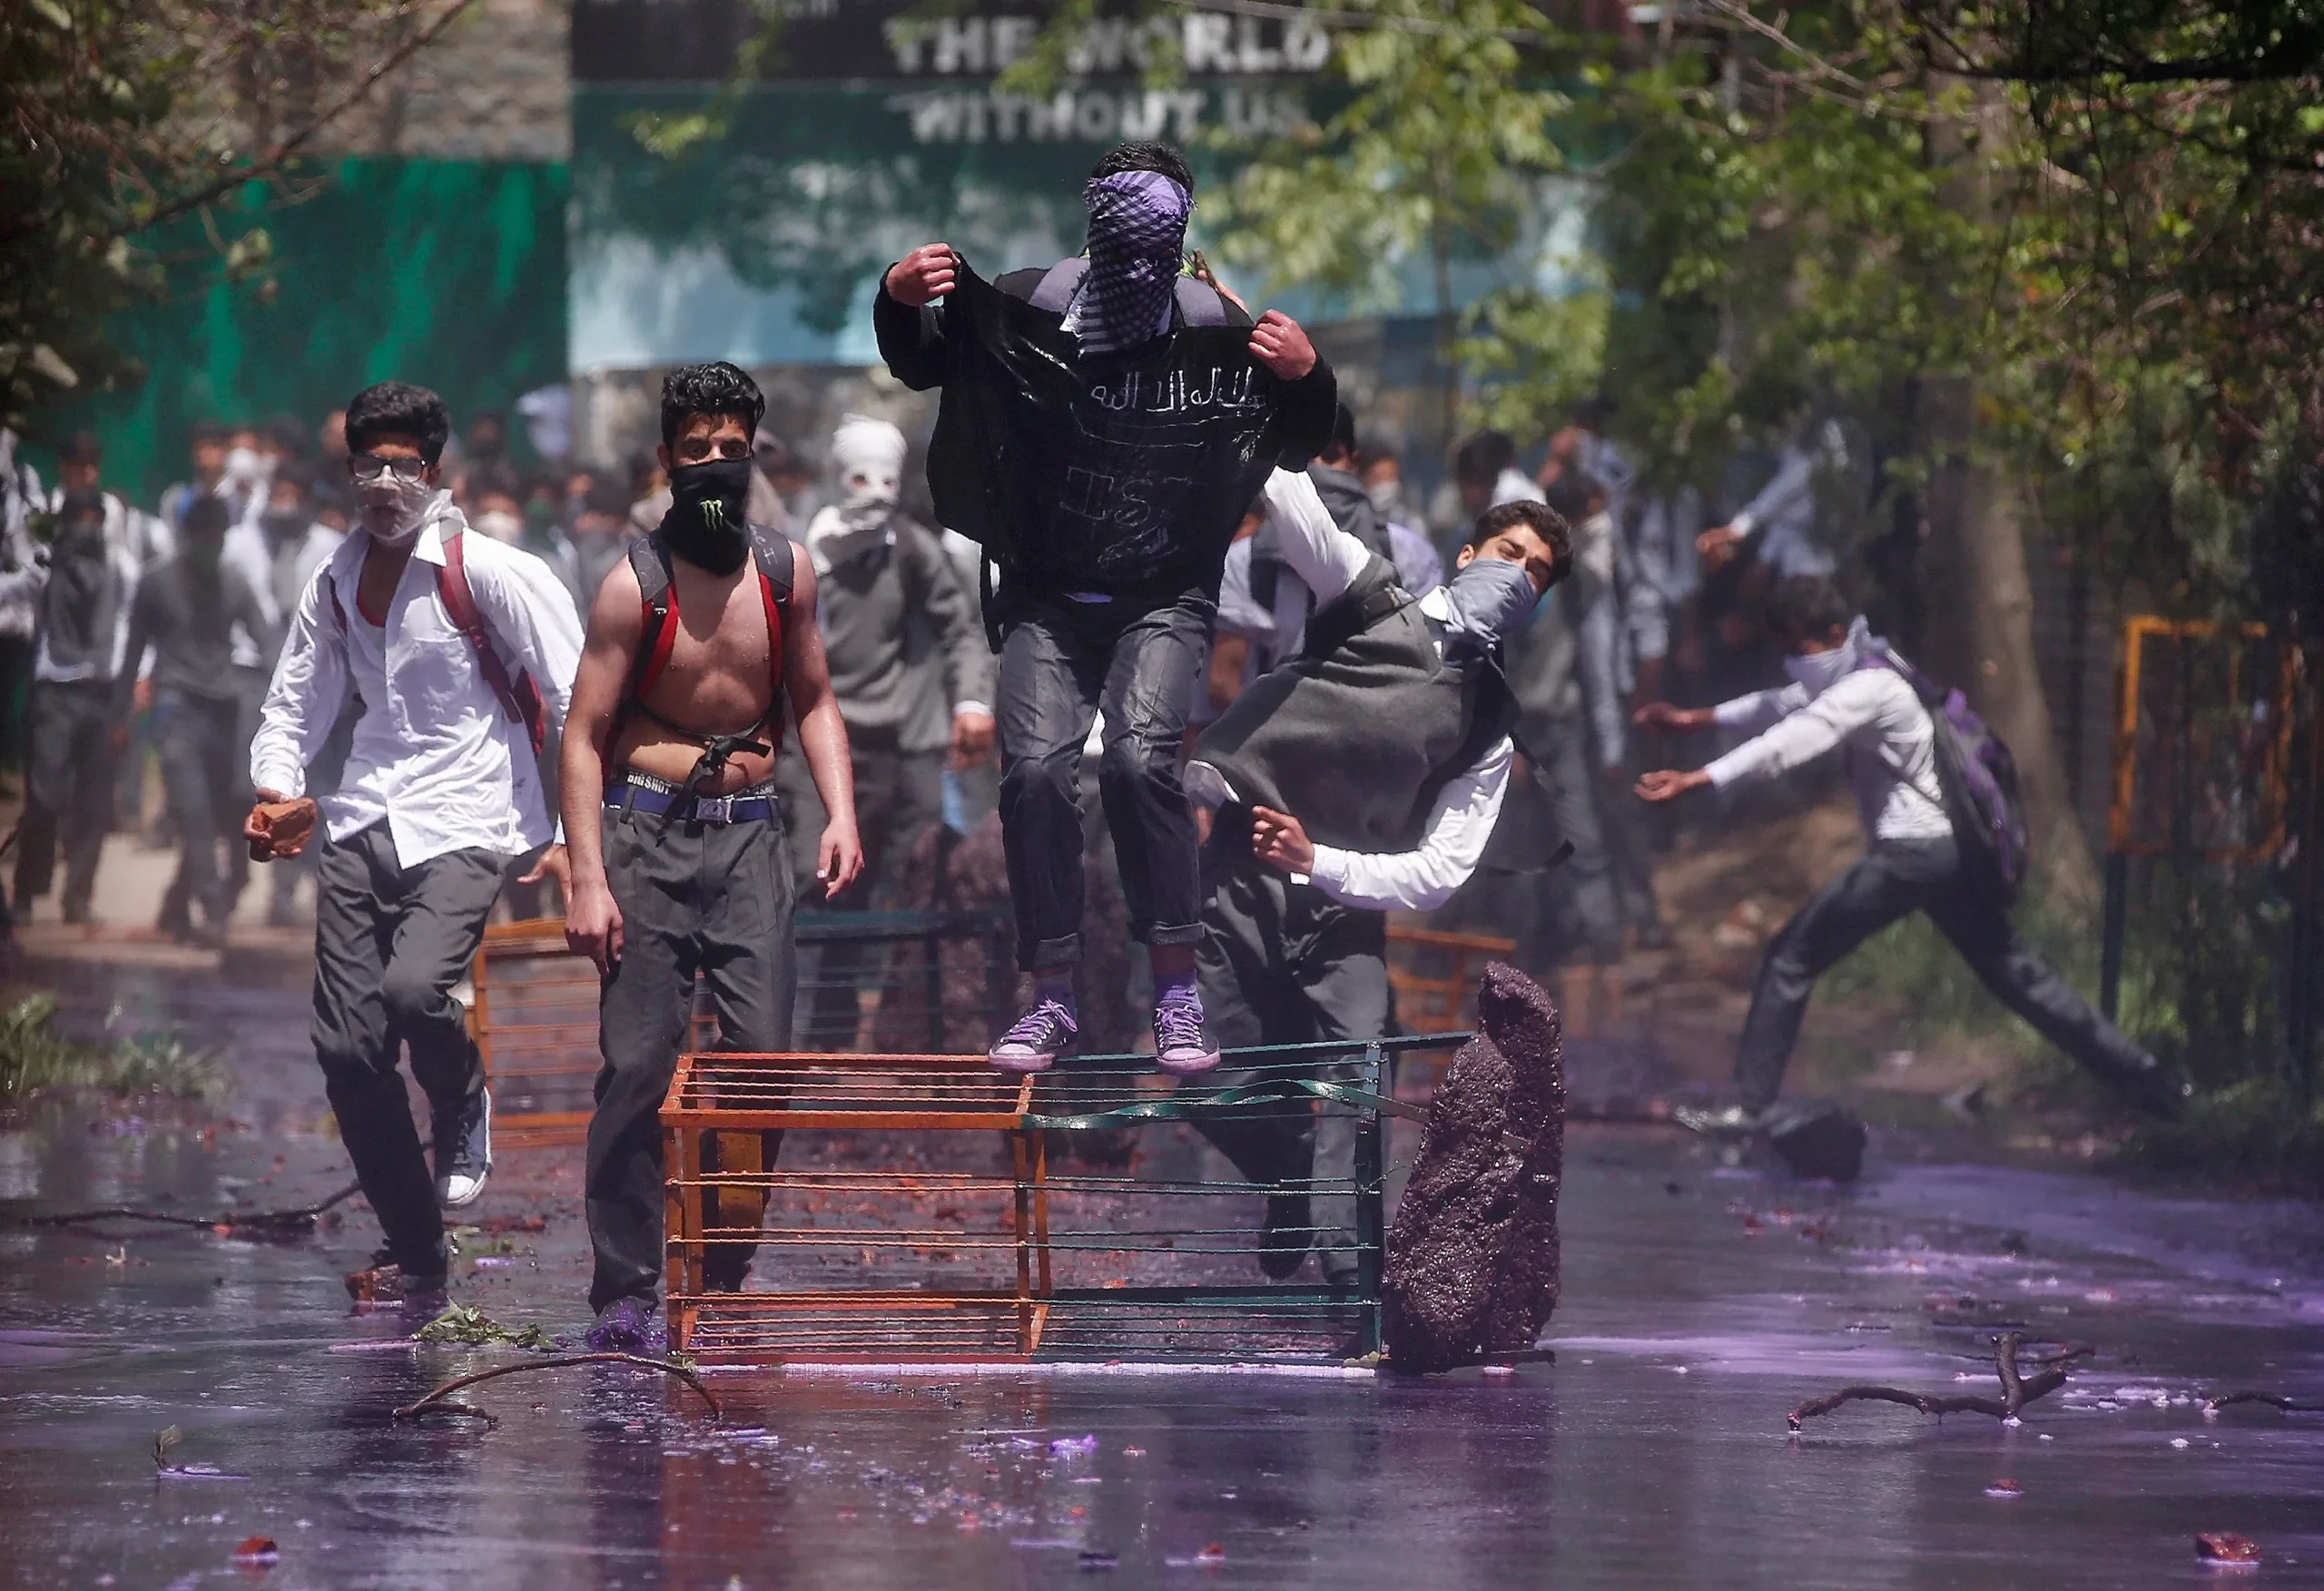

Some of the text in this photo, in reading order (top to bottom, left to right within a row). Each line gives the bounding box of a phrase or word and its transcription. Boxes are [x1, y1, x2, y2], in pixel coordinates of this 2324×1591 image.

[883, 12, 1330, 74] THE WORLD
[911, 89, 1208, 145] WITHOUT
[626, 771, 672, 796] BIGSHOT
